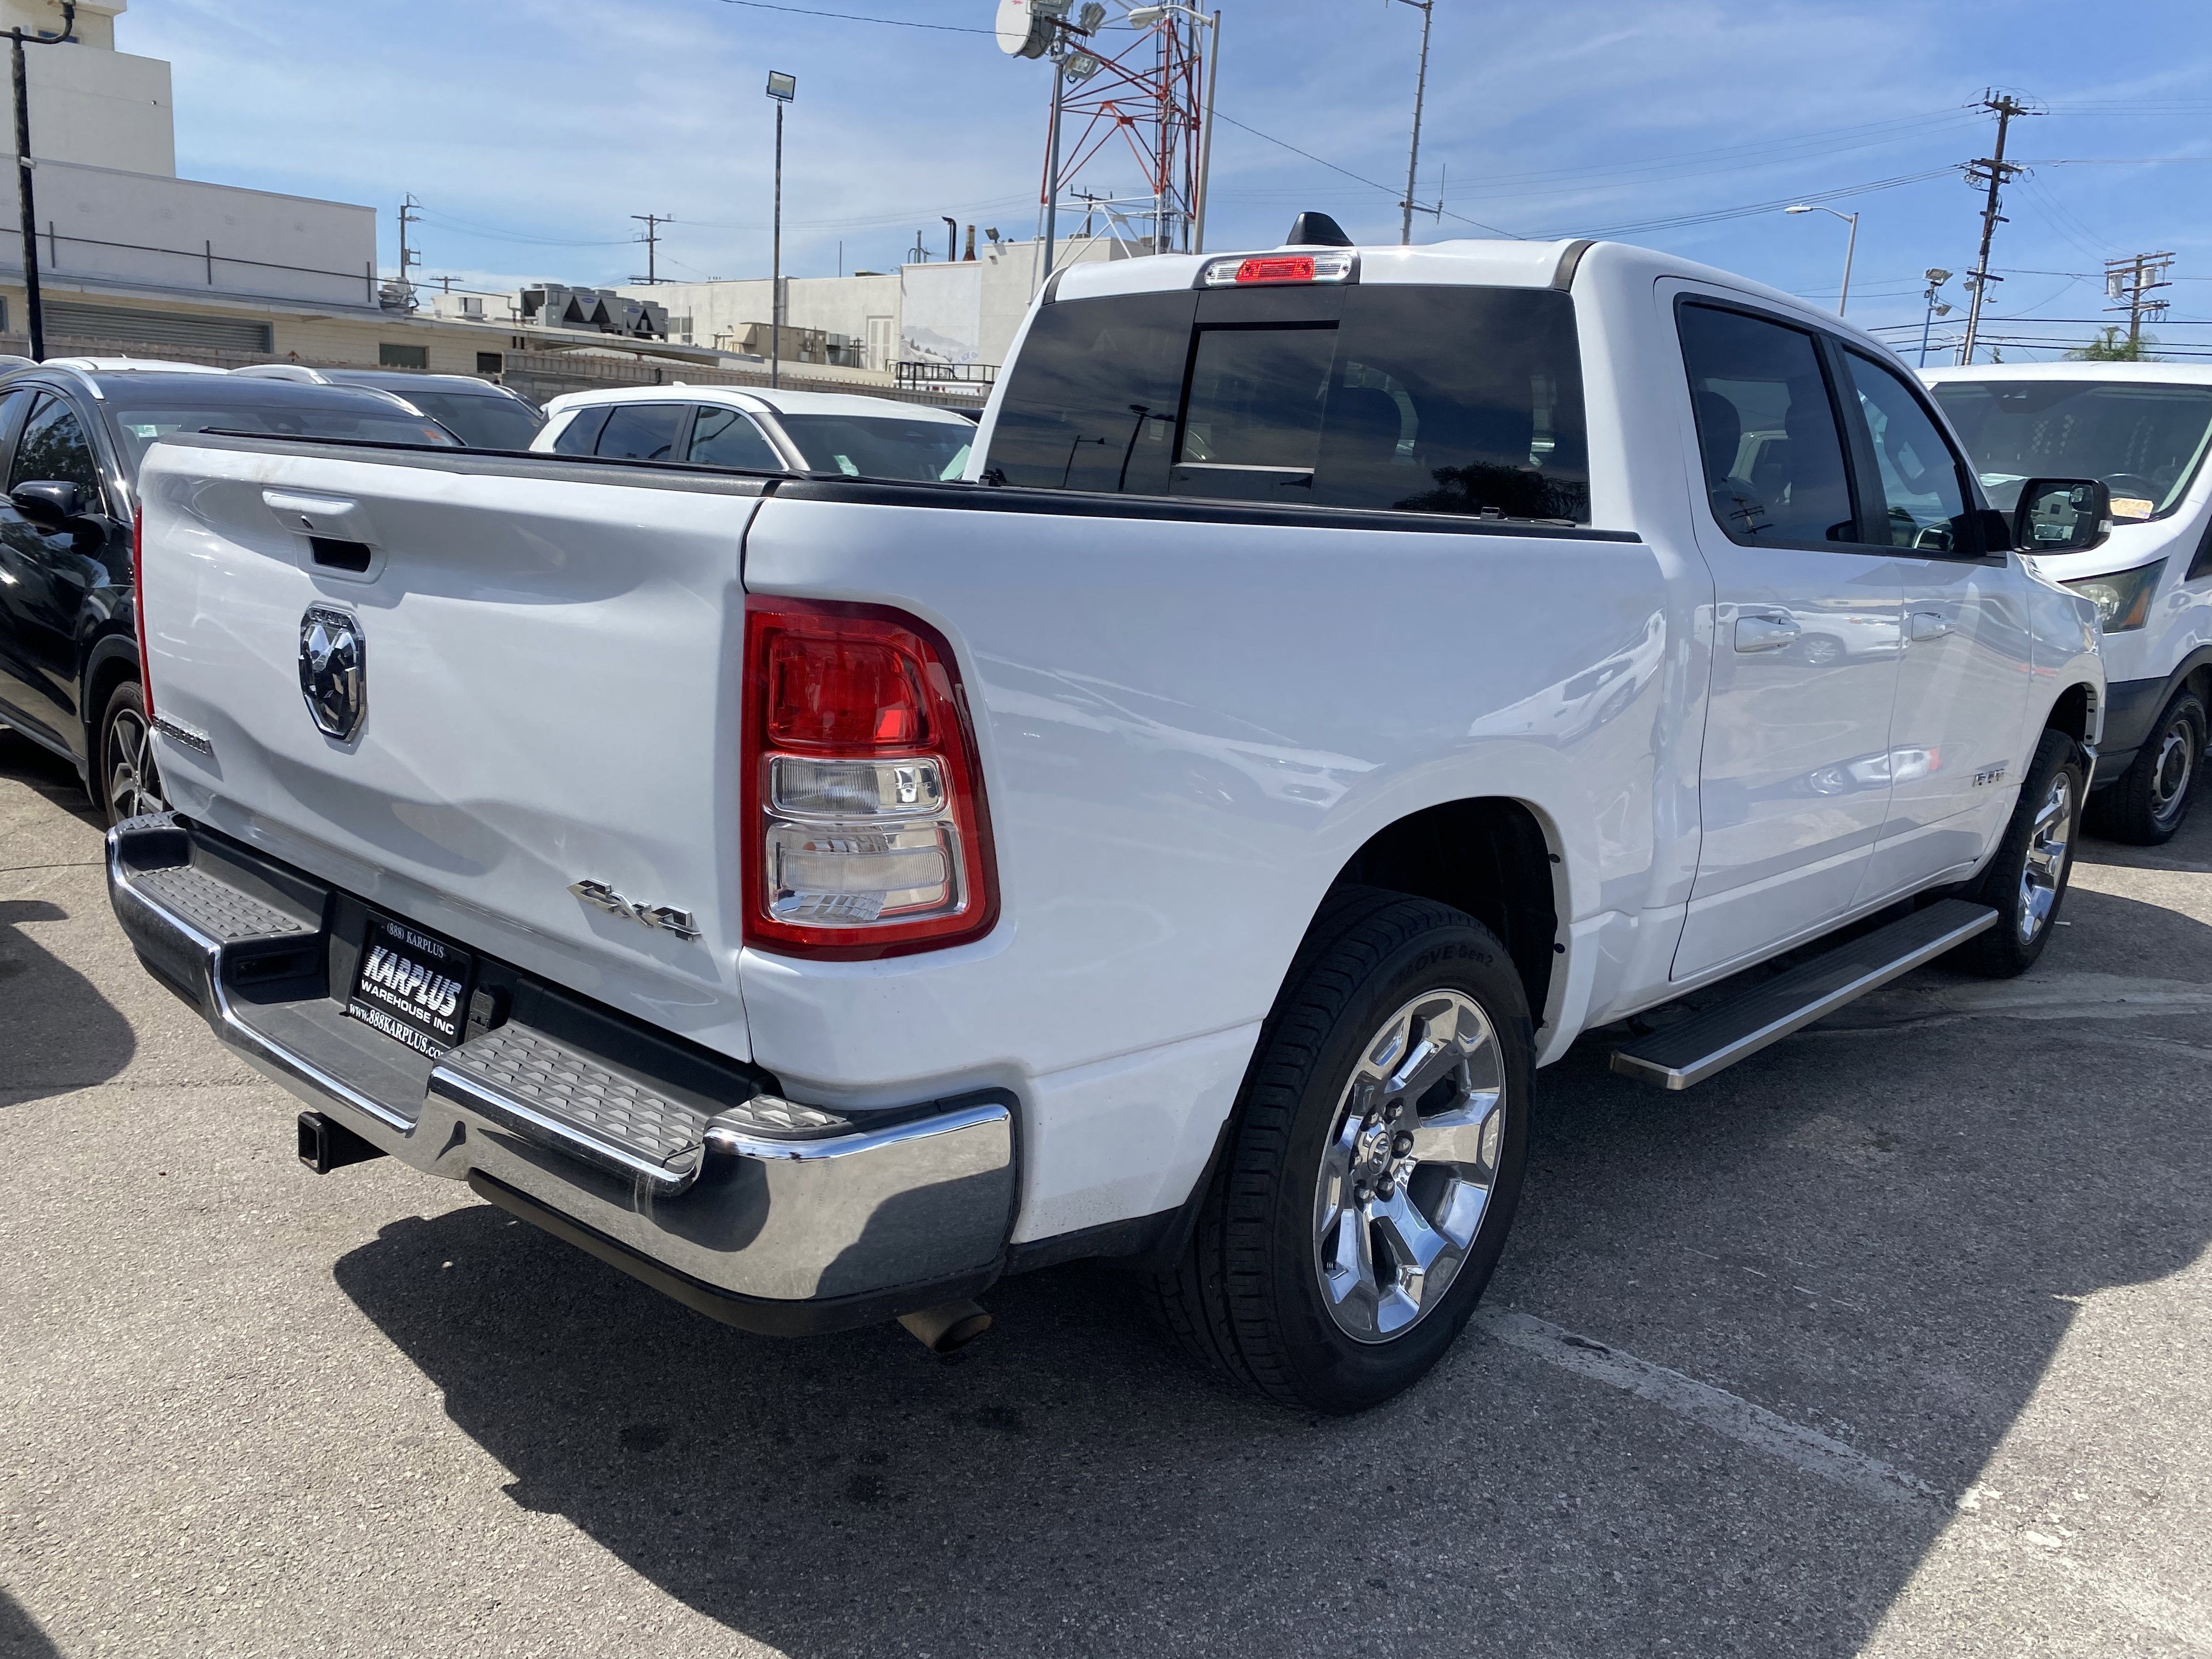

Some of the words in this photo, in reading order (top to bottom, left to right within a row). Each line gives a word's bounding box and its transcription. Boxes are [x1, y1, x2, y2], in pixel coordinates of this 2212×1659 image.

[387, 922, 404, 939] (888)
[407, 931, 444, 958] KARPLUS
[362, 979, 431, 1024] WAREHOUSE
[433, 1017, 454, 1035] INC
[363, 945, 462, 1017] KARPLUS
[349, 1003, 444, 1059] www.888KARPLUS.co
